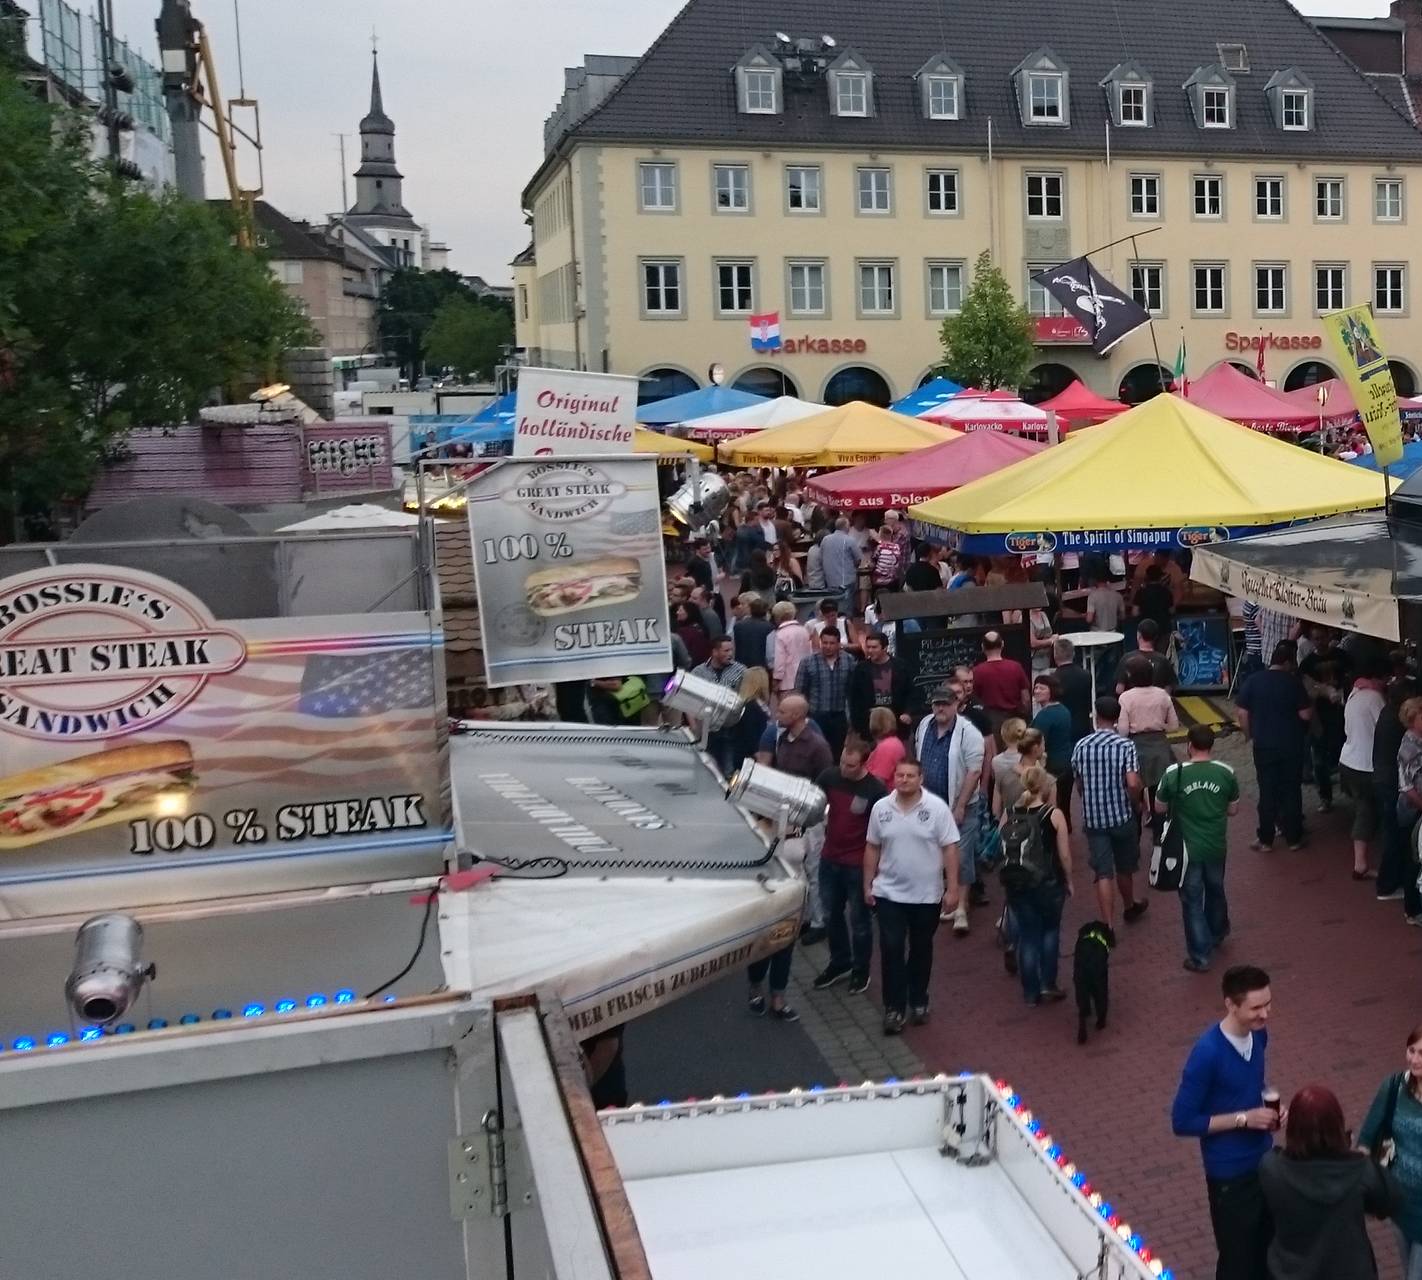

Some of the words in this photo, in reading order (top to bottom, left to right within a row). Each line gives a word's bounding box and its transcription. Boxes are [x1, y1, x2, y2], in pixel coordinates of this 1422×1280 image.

[1226, 332, 1322, 353] Sparkasse
[537, 390, 619, 415] Original
[518, 417, 632, 442] holländische
[517, 487, 560, 498] GREAT
[565, 483, 611, 496] STEAK
[860, 496, 884, 506] aus
[890, 493, 930, 506] Polen
[528, 499, 599, 520] SANDWICH
[482, 534, 540, 564] 100
[545, 532, 573, 557] %
[1008, 536, 1037, 550] Tiger
[1063, 531, 1080, 545] The
[1084, 531, 1111, 545] Spirit
[1114, 530, 1125, 543] of
[1127, 530, 1171, 545] Singapur
[1181, 530, 1209, 544] Tiger
[555, 618, 660, 651] STEAK
[90, 638, 210, 672] STEAK
[130, 815, 215, 854] 100
[224, 809, 266, 843] %
[277, 795, 428, 841] STEAK
[606, 978, 666, 1017] FRISCH
